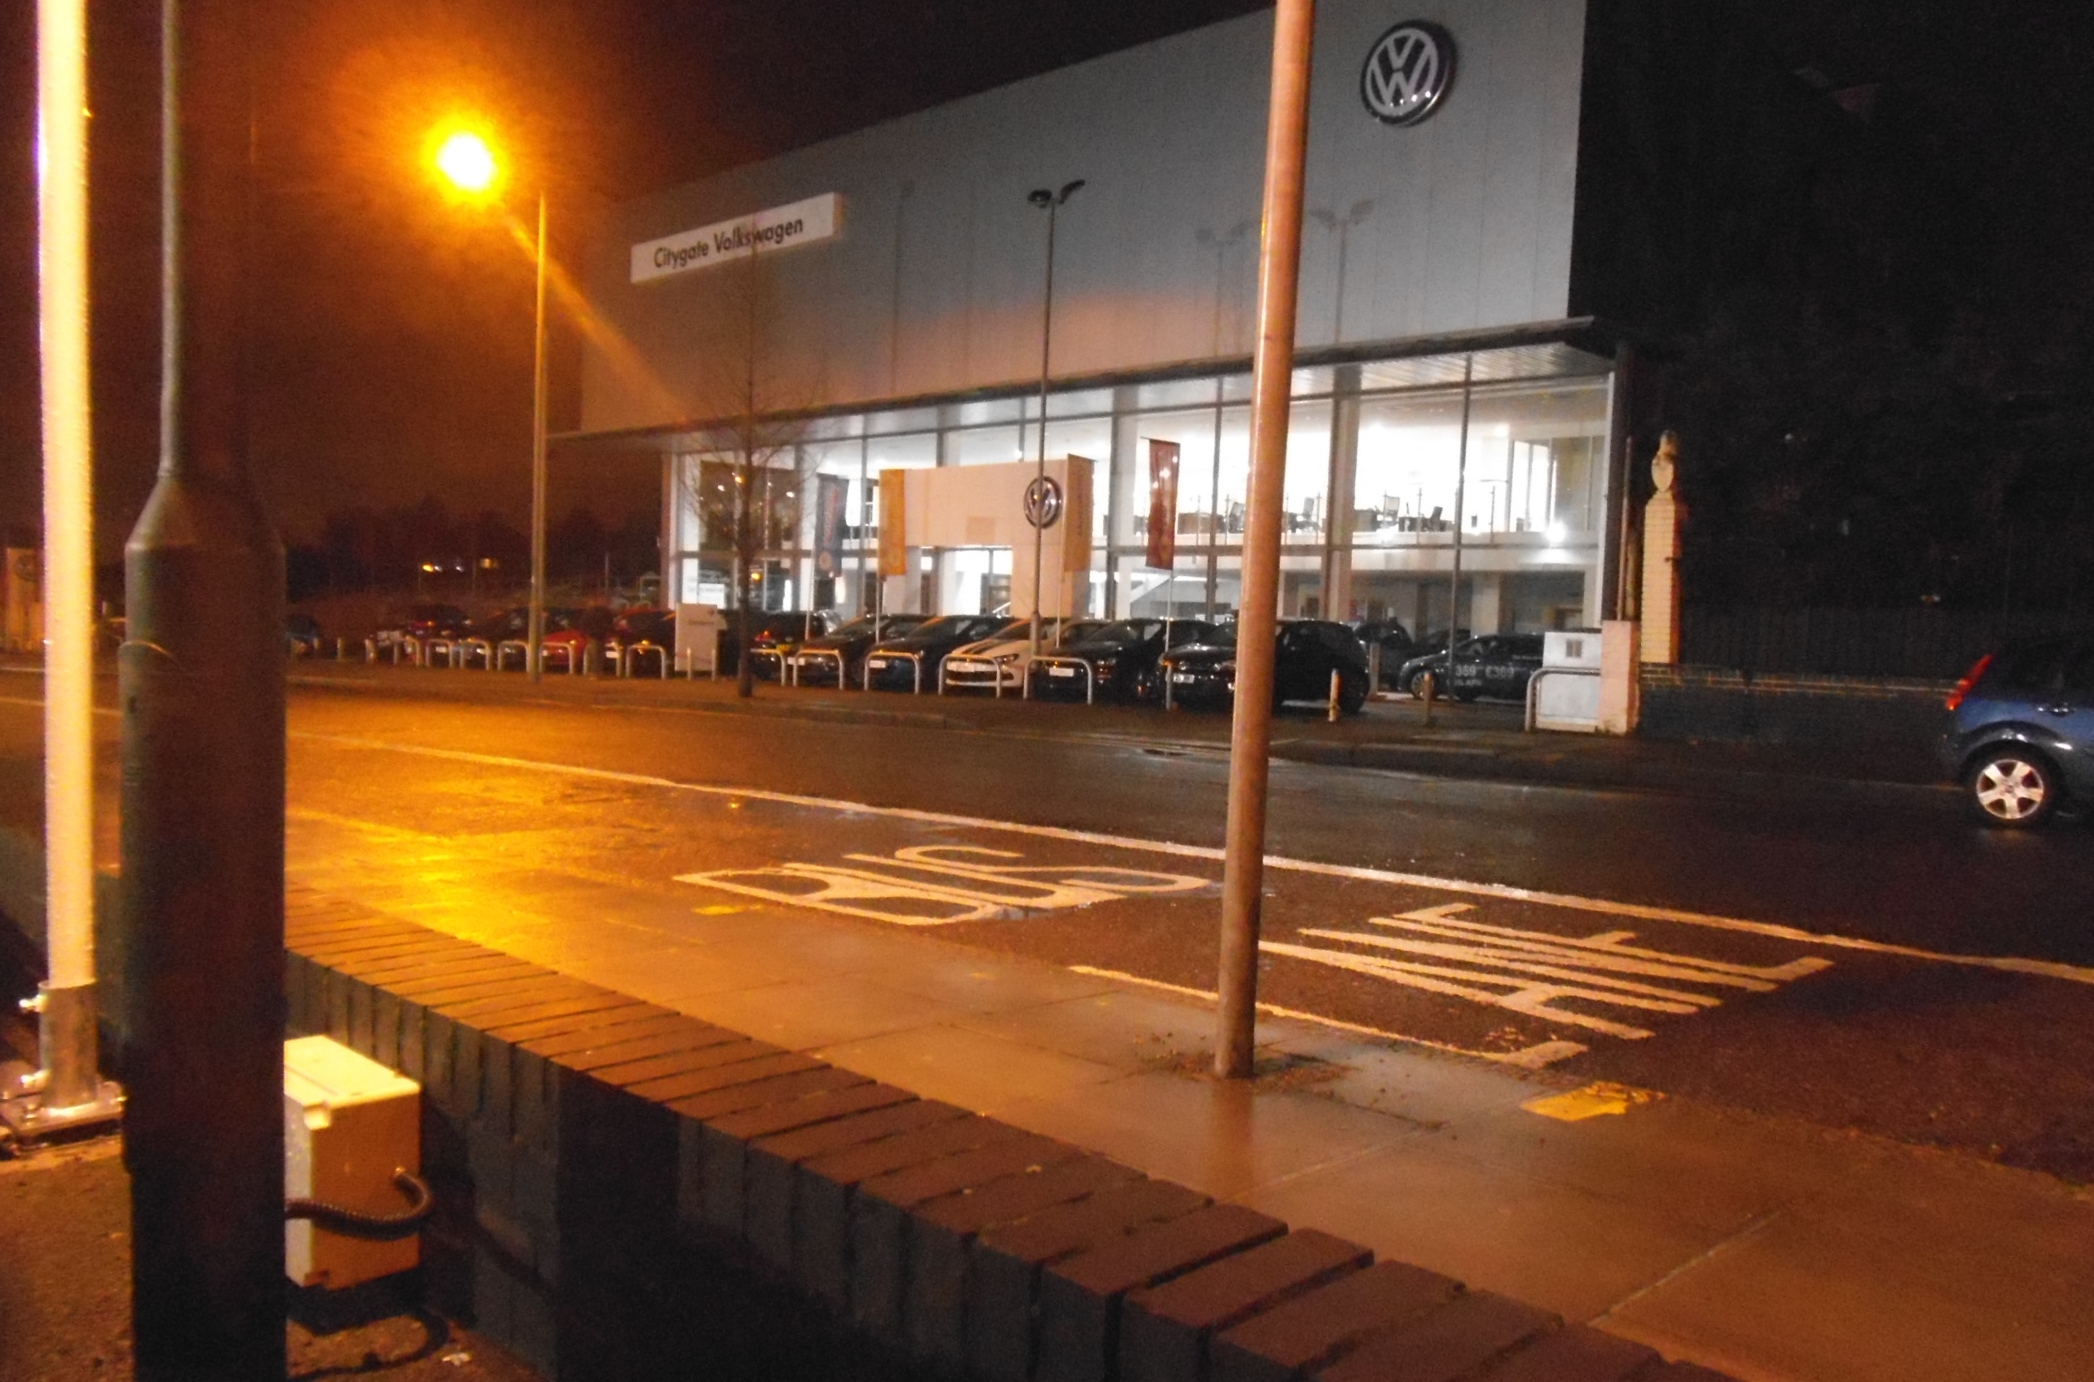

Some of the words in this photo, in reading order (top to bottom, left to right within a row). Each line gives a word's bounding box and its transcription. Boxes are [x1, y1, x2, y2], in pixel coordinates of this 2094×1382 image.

[653, 241, 708, 269] Citygate
[713, 218, 803, 254] Volkswagen
[672, 845, 1210, 926] BUS
[1068, 903, 1834, 1070] LANE
